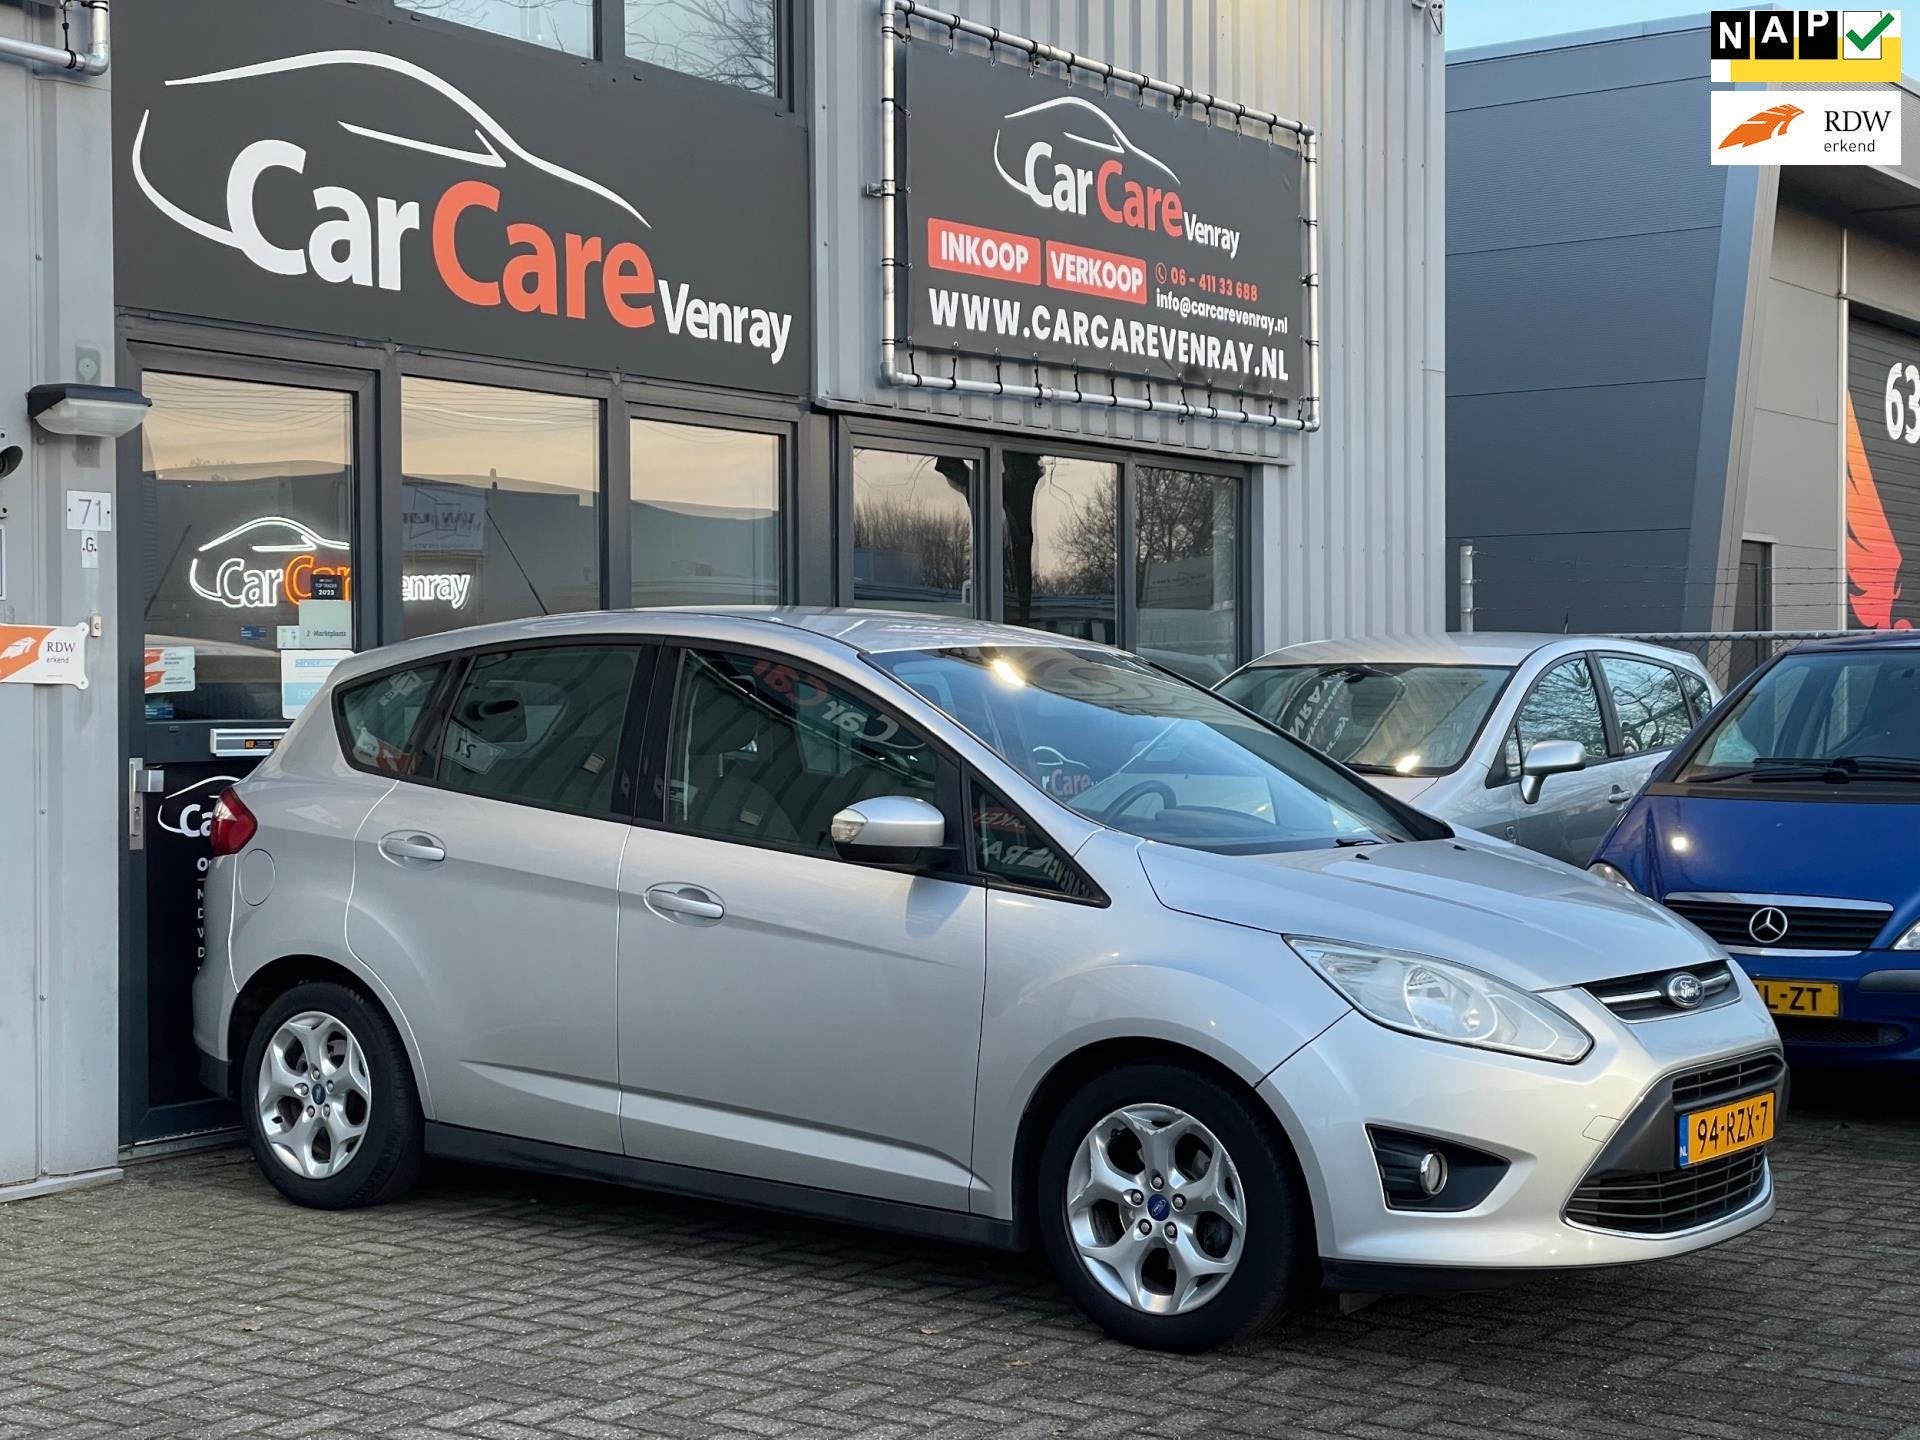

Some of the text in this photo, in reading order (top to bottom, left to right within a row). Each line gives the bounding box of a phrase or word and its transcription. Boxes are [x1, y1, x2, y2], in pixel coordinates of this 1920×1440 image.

[1183, 211, 1241, 259] Venray
[940, 229, 1144, 296] INKOOP VERKOOP
[1170, 266, 1186, 287] 06
[1199, 273, 1216, 293] 411
[1219, 277, 1233, 296] 33
[1236, 281, 1258, 302] 688
[658, 278, 793, 365] Venray
[928, 287, 1290, 381] WWW.CARCAREVENRAY.NL
[1156, 287, 1288, 336] info@carcarevenray.nl
[1885, 362, 1920, 444] 63
[78, 498, 102, 526] 71
[47, 641, 77, 653] RDW
[1755, 985, 1823, 1012] L-ZT
[1696, 1100, 1769, 1155] 94-RZX-7
